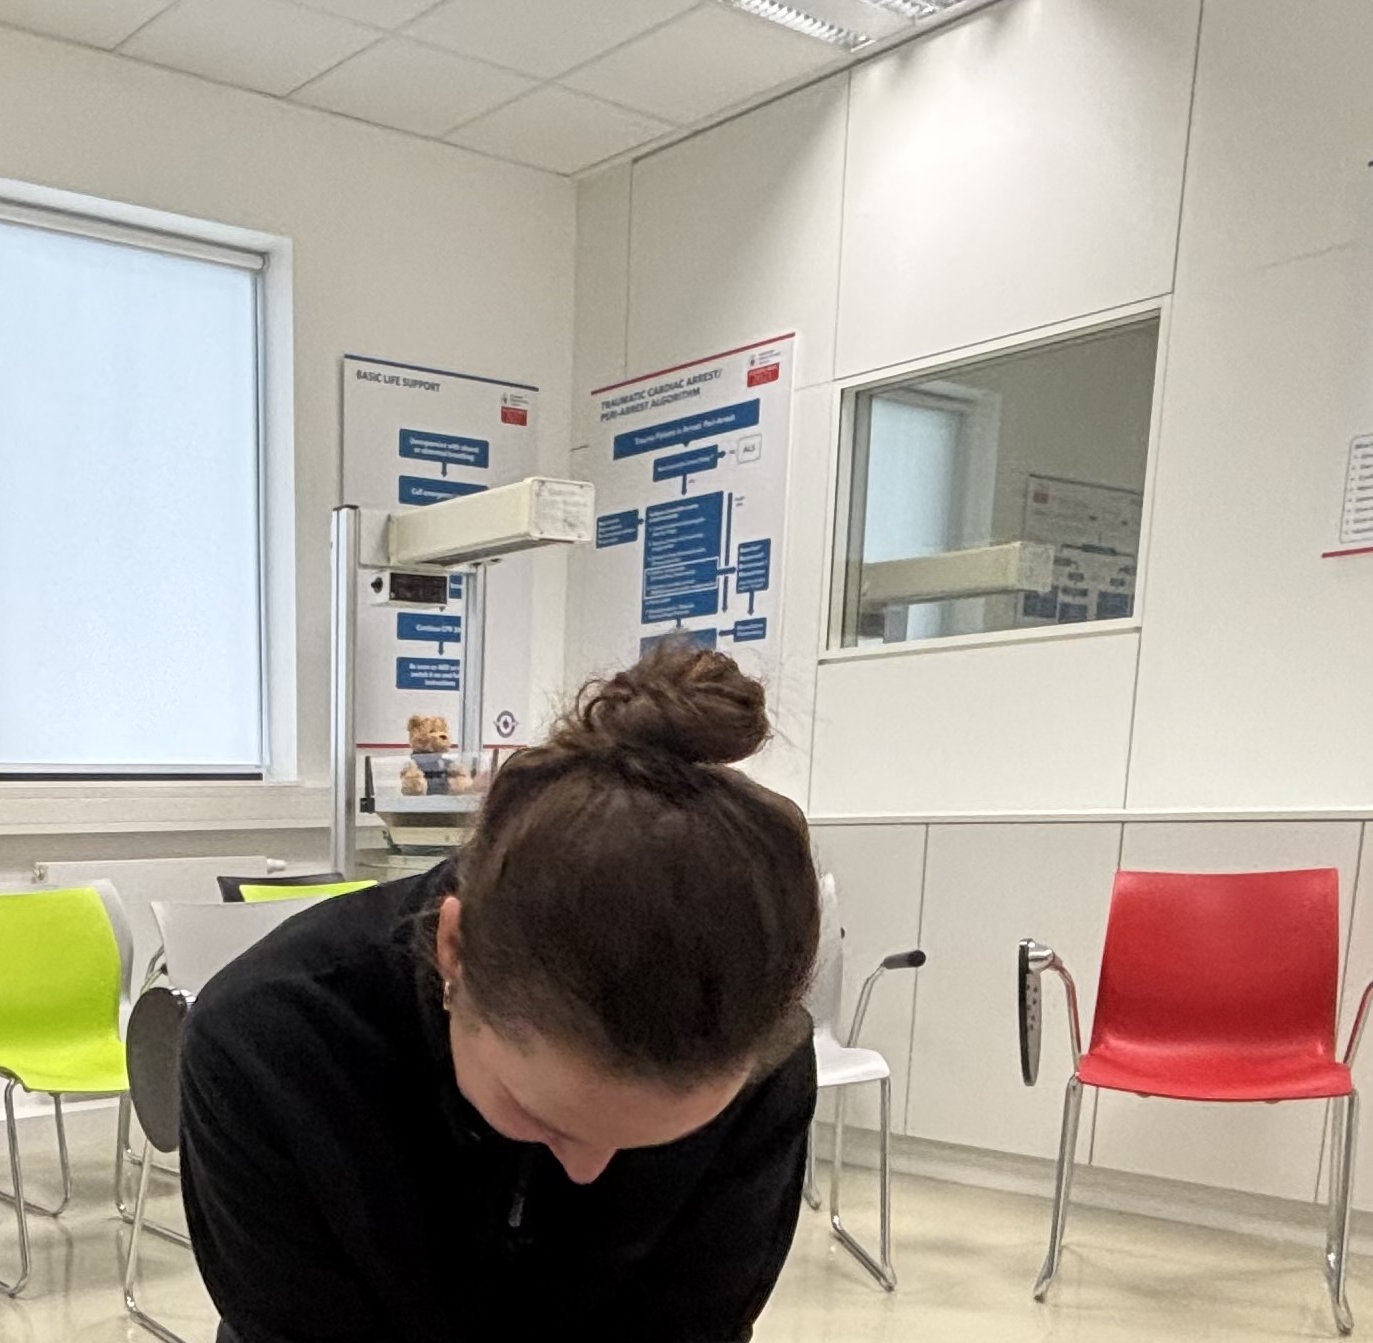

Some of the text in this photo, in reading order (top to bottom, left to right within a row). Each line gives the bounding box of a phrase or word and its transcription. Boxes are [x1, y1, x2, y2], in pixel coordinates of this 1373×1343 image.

[356, 369, 441, 392] BASIC LIFE SUPPORT
[601, 389, 646, 411] TRAUMATIC
[647, 379, 685, 399] CARDIAC
